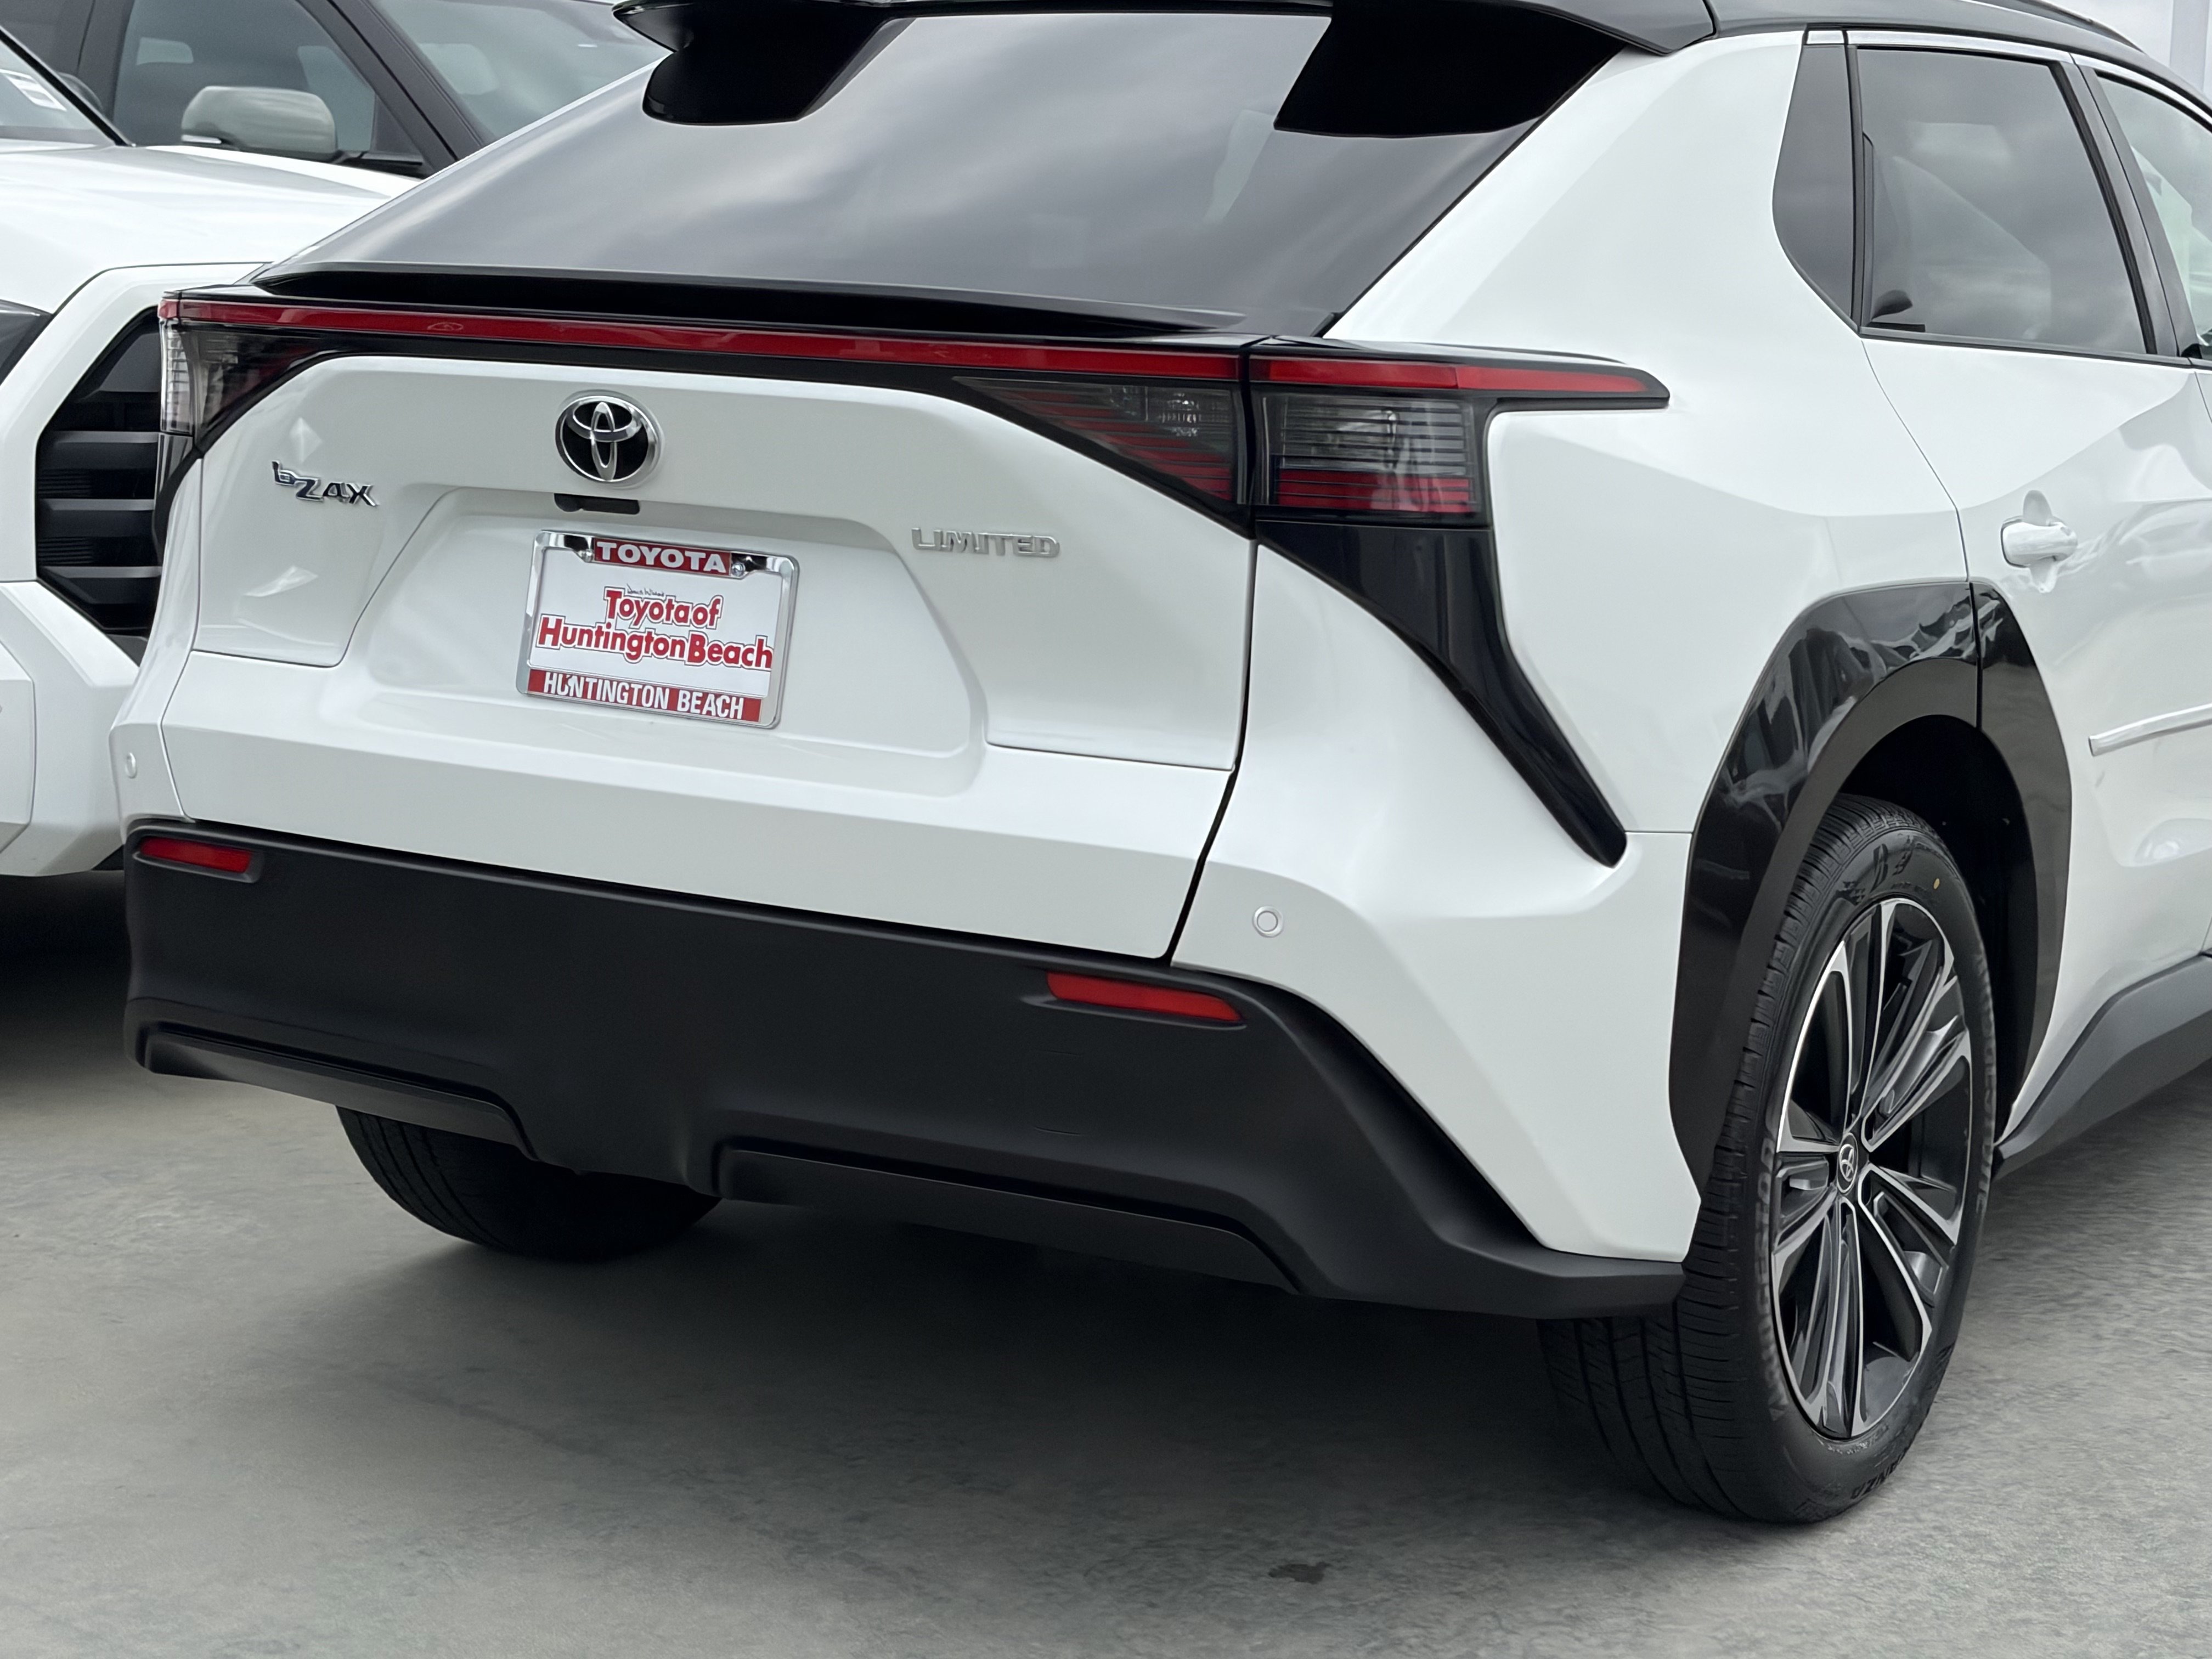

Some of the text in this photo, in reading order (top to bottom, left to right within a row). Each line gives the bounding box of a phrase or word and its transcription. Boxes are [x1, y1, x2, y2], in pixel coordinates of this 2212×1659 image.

[596, 540, 726, 573] TOYOTA
[911, 527, 1060, 558] LIMITED
[687, 631, 772, 669] Beach
[544, 672, 744, 719] HUNTINGTON BEACH
